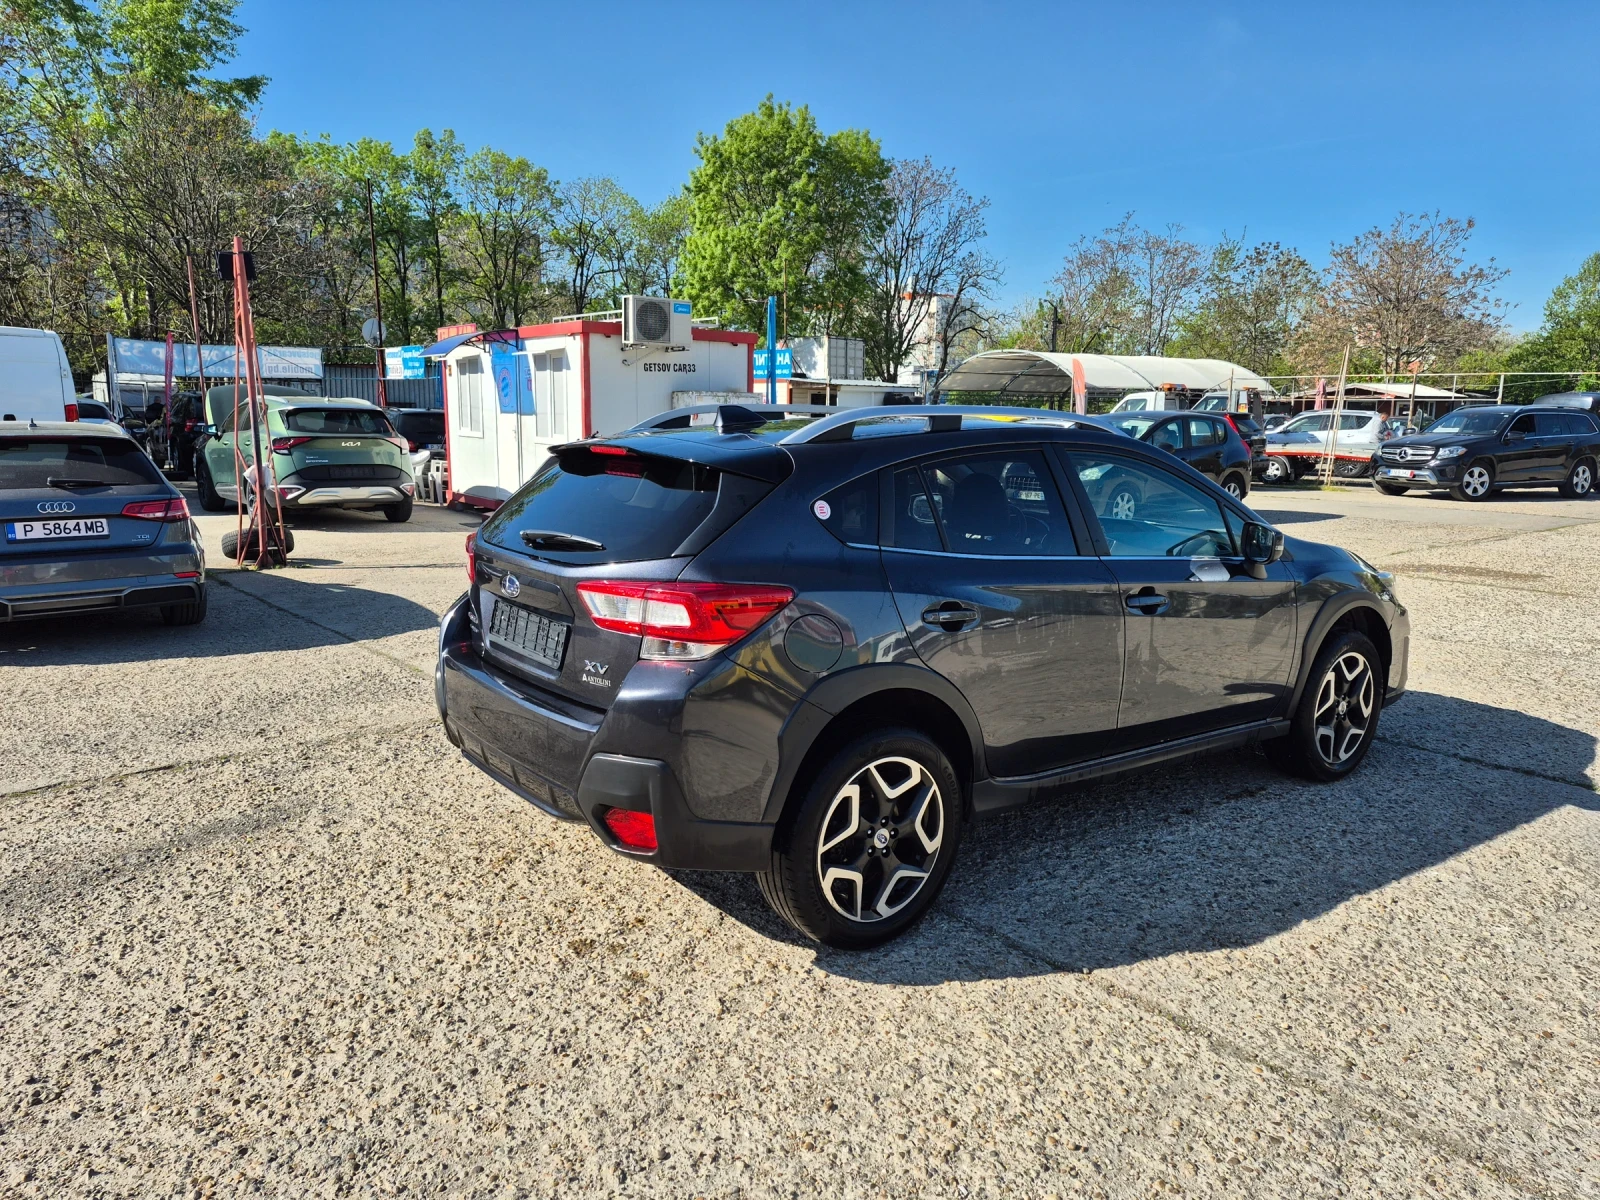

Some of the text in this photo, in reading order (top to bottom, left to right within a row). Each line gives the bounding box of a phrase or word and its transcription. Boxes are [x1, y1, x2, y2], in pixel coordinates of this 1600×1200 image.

[643, 363, 696, 373] GETSOV CAR33
[23, 524, 34, 537] P
[42, 522, 82, 536] 5864
[85, 521, 105, 534] MB
[584, 660, 609, 675] XV
